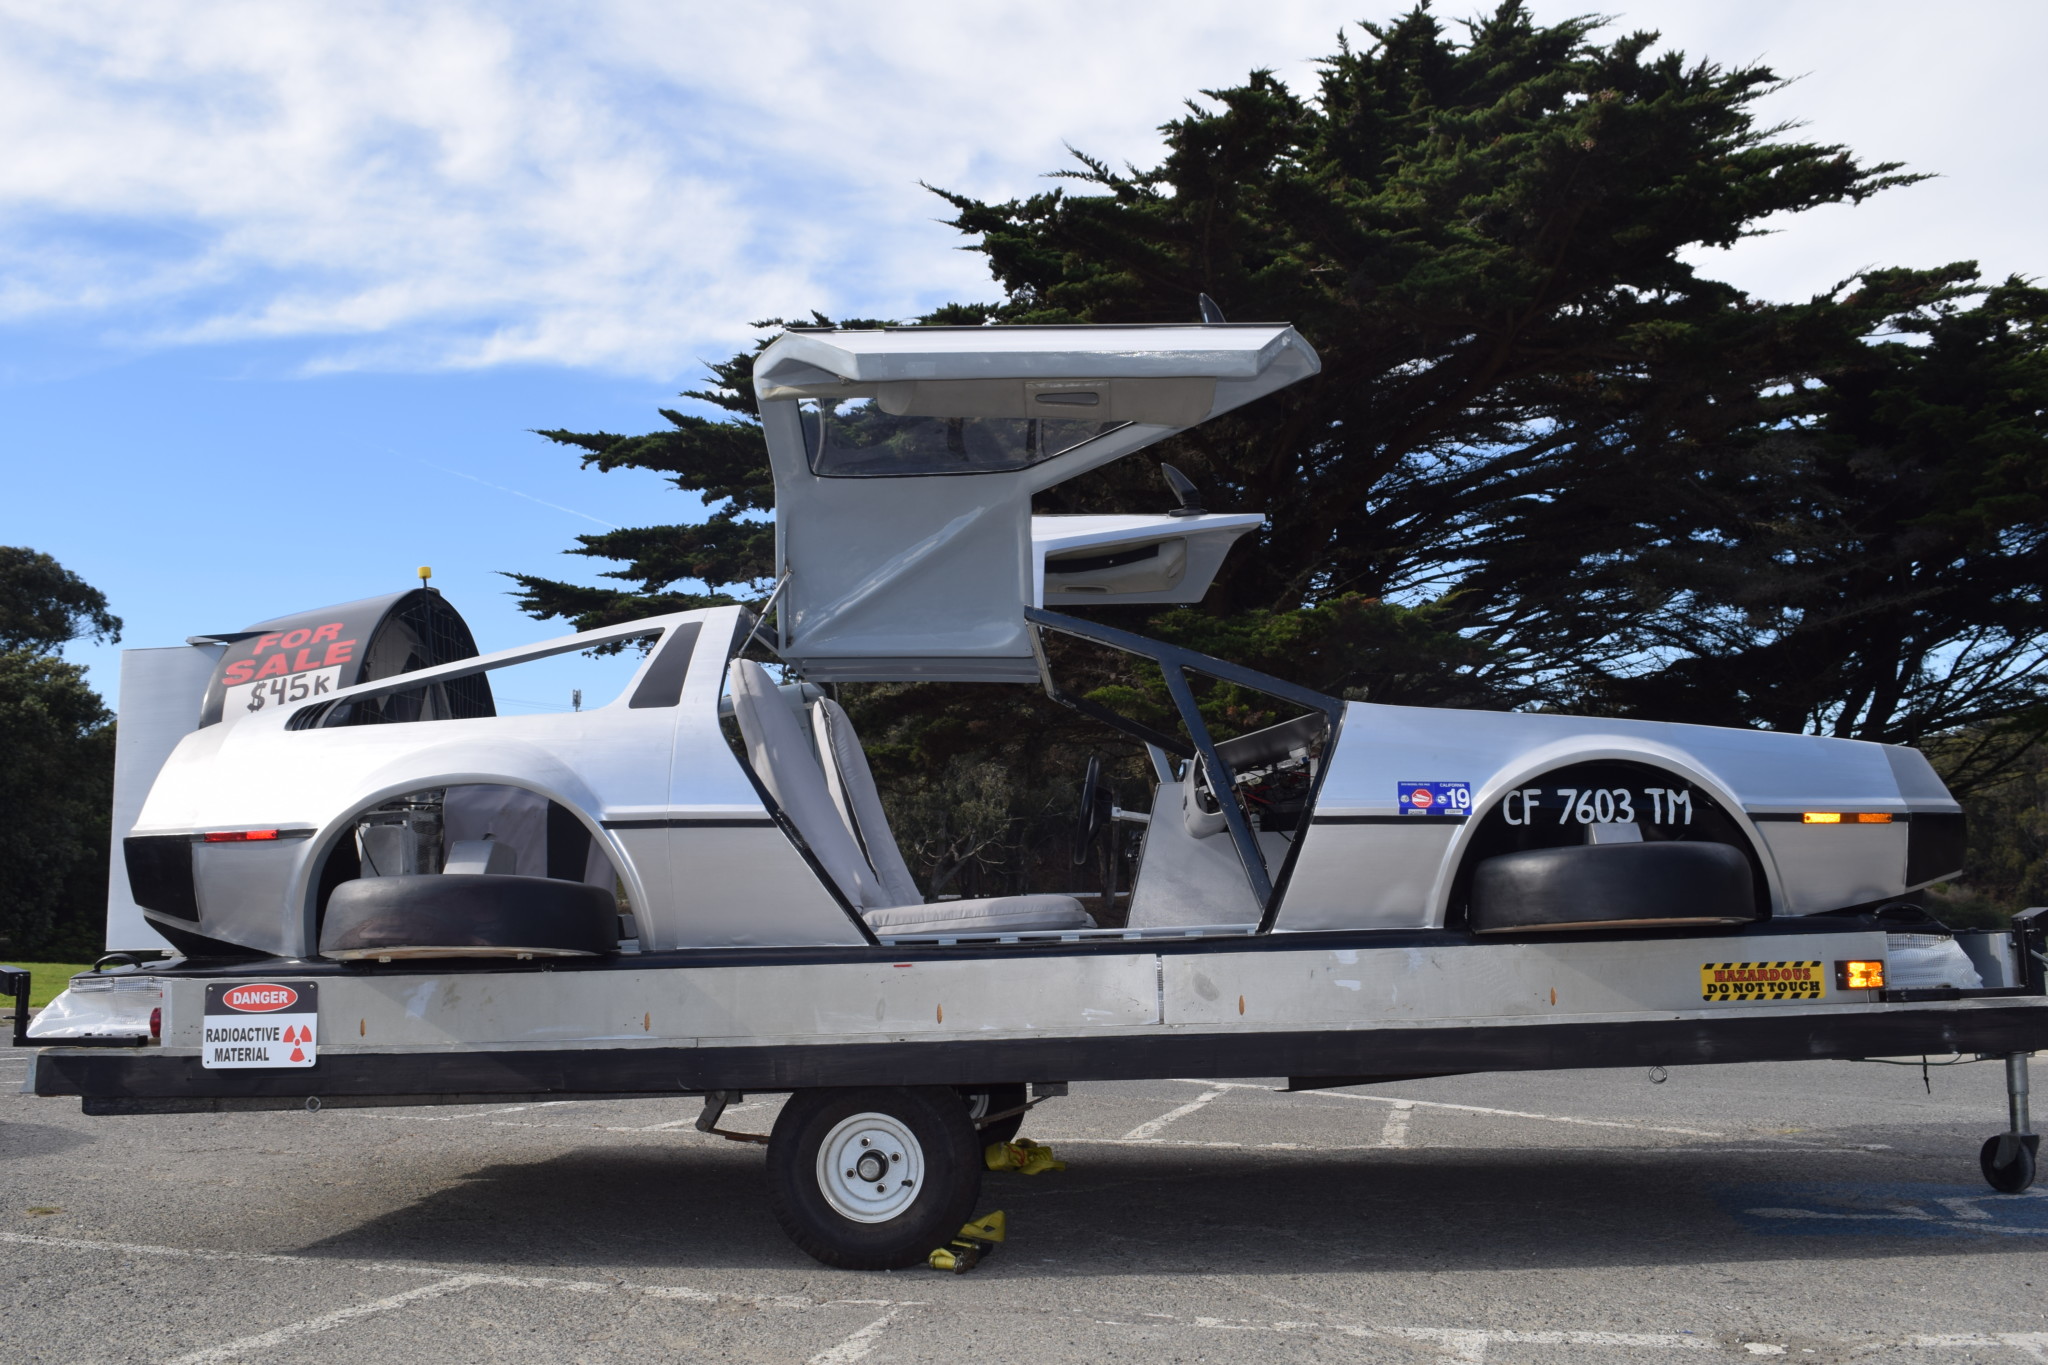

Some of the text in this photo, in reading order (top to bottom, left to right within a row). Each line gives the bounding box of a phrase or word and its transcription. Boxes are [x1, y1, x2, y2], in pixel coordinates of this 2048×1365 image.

[252, 622, 344, 655] FOR
[222, 639, 357, 685] SALE
[1447, 788, 1470, 809] 19
[1503, 789, 1693, 825] CF 7603 TM
[1714, 968, 1812, 982] HAZARDOUS
[1707, 981, 1820, 994] DO NOT TOUCH
[233, 991, 288, 1005] DANGER
[206, 1027, 280, 1043] RADIOACTIVE
[214, 1047, 270, 1062] MATERIAL
